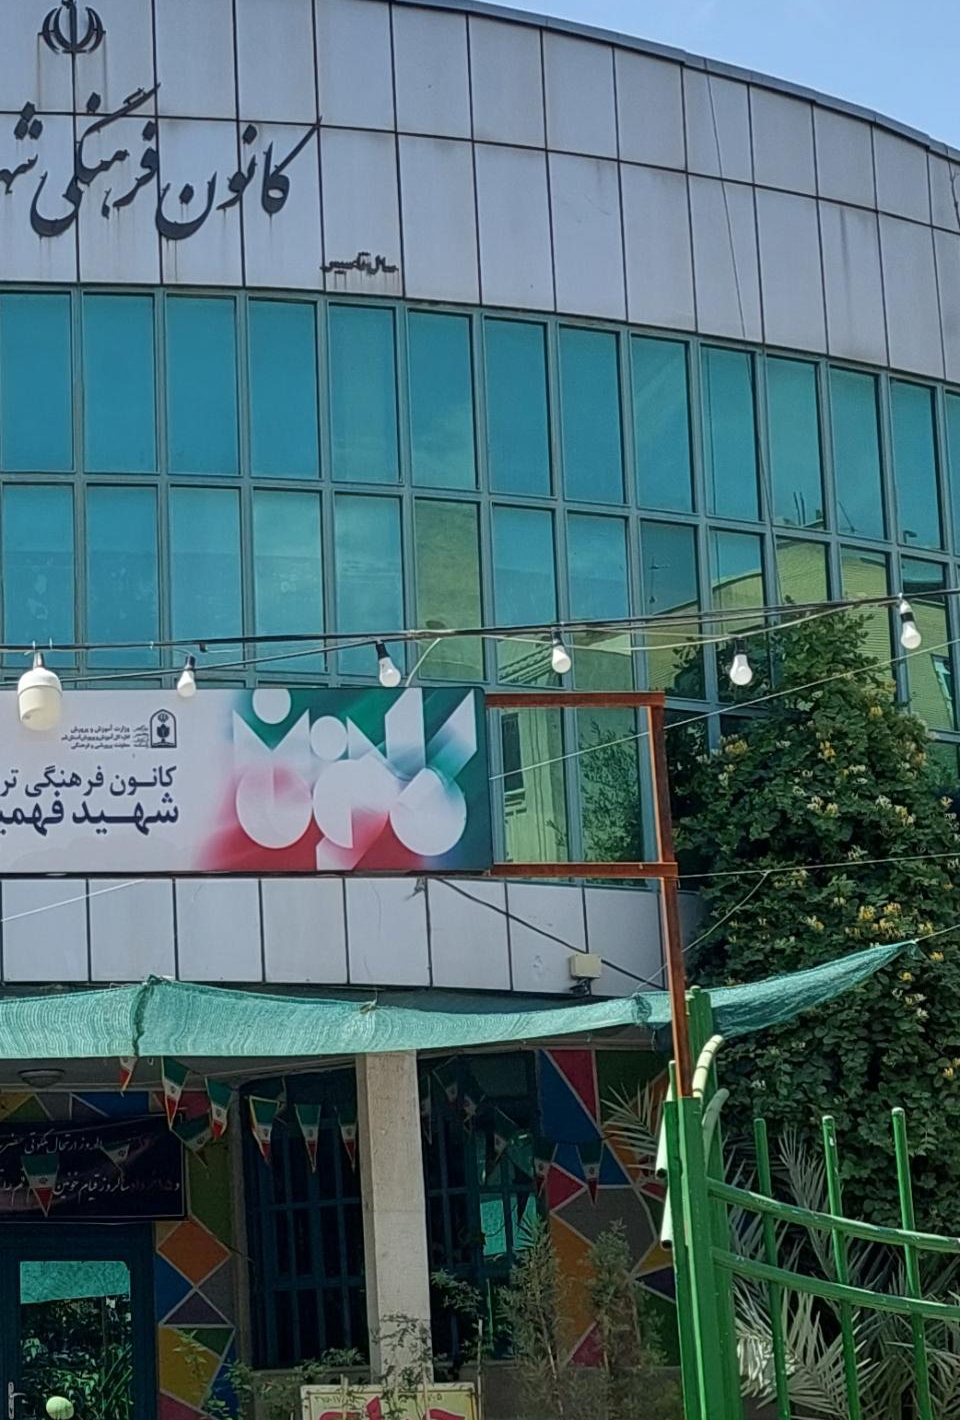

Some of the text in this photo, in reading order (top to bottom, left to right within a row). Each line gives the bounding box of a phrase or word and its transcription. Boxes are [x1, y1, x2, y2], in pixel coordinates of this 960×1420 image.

[30, 83, 160, 238] فرهنگی
[155, 116, 324, 241] کانون
[24, 765, 103, 798] فرهنگی
[109, 765, 177, 797] کانون
[71, 792, 180, 837] شهید
